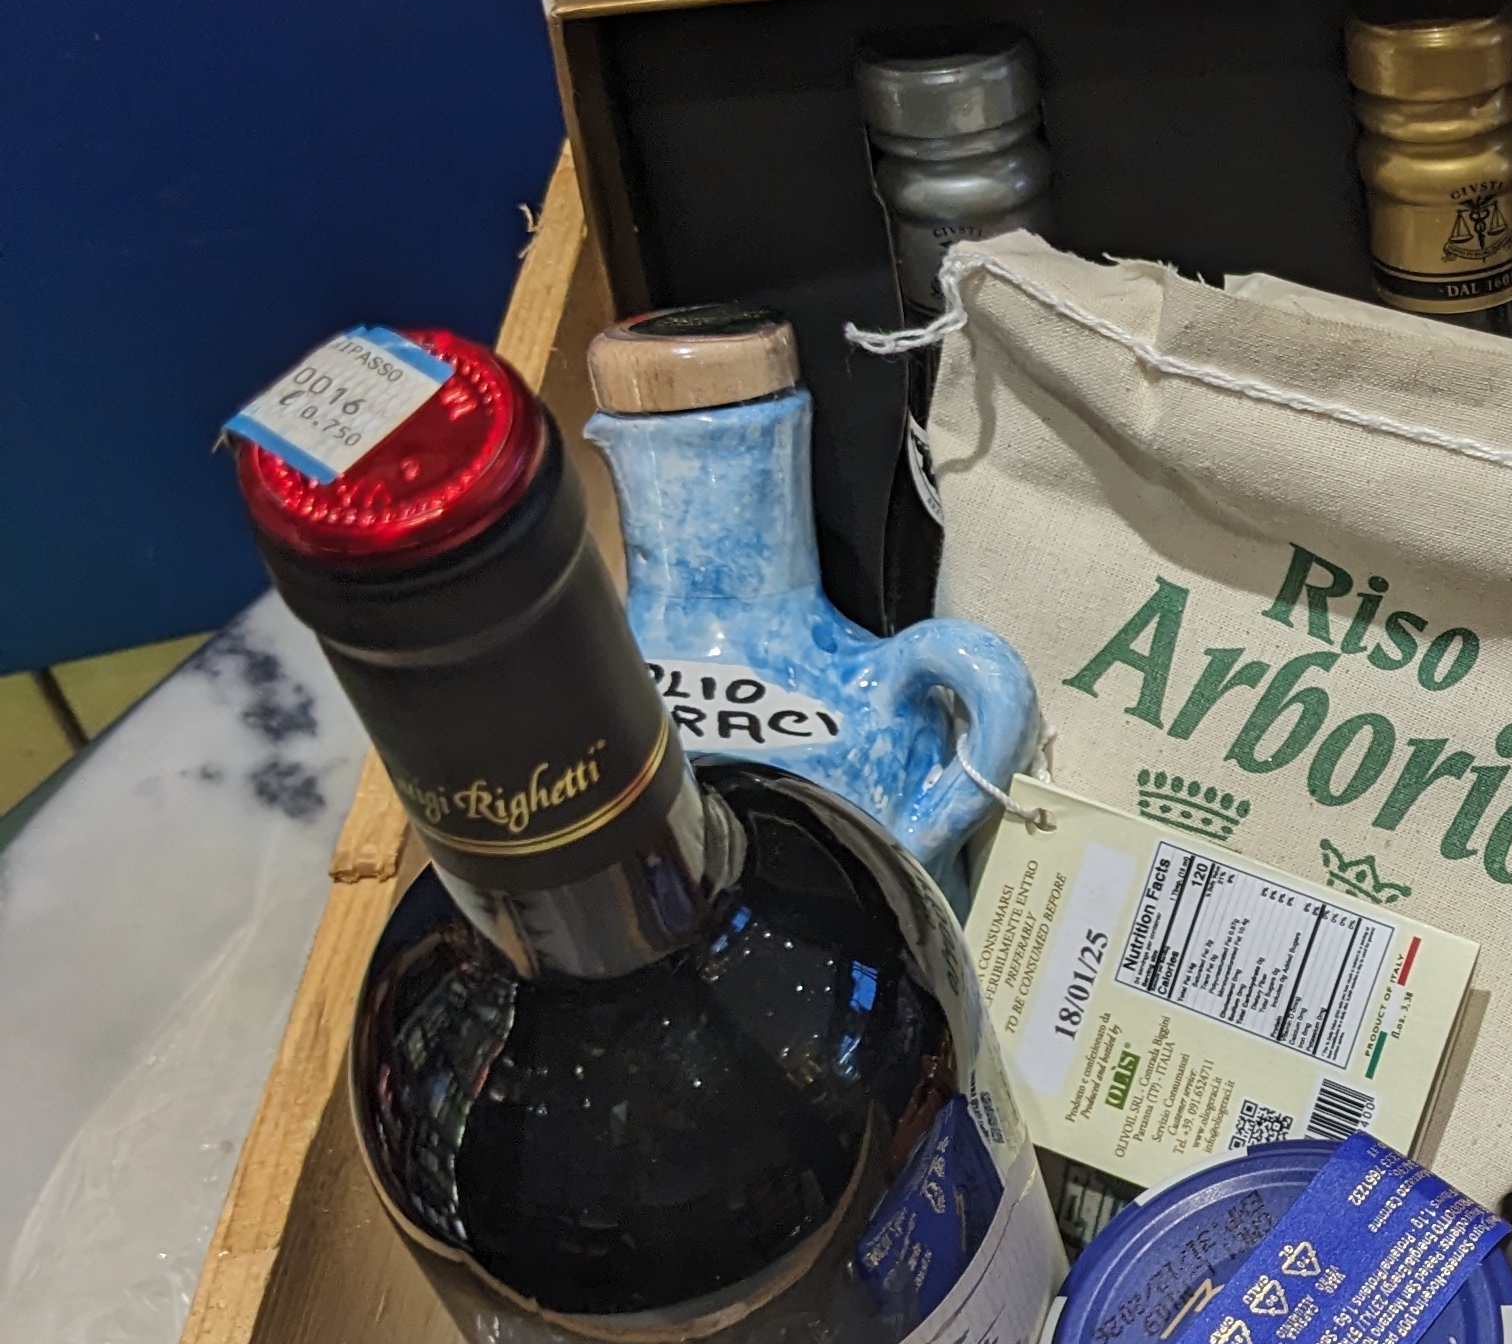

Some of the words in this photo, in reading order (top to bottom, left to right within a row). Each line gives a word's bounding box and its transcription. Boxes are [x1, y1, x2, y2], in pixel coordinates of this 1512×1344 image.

[1447, 284, 1480, 297] DAL
[325, 334, 404, 383] IPASSO
[1261, 542, 1481, 692] Riso
[668, 709, 840, 743] RACI
[455, 746, 603, 832] Righetti
[1015, 858, 1039, 906] ENTRO
[1042, 871, 1067, 922] BEFORE
[1122, 902, 1156, 971] Nutrition
[1146, 856, 1170, 901] Facts
[977, 883, 1014, 971] CONSUMARSI
[1003, 910, 1038, 988] PREFERABLY
[1017, 922, 1051, 996] CONSUMED
[1157, 949, 1179, 996] Calories
[1190, 861, 1208, 889] 120
[1011, 996, 1026, 1014] BE
[1053, 927, 1109, 1041] 18/01/25
[1363, 1003, 1387, 1057] PRODUCT
[1382, 985, 1393, 1001] OF
[1389, 952, 1405, 983] ITALY
[1004, 1014, 1019, 1034] TO
[1098, 1033, 1116, 1063] bottled
[1108, 1022, 1123, 1036] by
[1139, 1046, 1160, 1087] Contrada
[1153, 1014, 1173, 1047] Biggini
[1065, 1083, 1086, 1123] Prodotto
[1082, 1023, 1107, 1077] confezionato
[1098, 1010, 1111, 1024] da
[1092, 1062, 1106, 1081] and
[1146, 1081, 1162, 1104] (TP)
[1155, 1040, 1175, 1076] ITALIA
[1151, 1108, 1171, 1143] Servizio
[1163, 1052, 1190, 1108] Consumatori
[1079, 1080, 1100, 1119] Produced
[1167, 1097, 1187, 1136] Customer
[1172, 1136, 1187, 1156] Tel.
[1187, 1058, 1214, 1115] 091.6524711
[1191, 1075, 1223, 1149] www.oliogeraci.it
[1203, 1079, 1235, 1153] info@oliogeraci.it
[1400, 1278, 1421, 1301] San
[1413, 1248, 1445, 1284] Peeled
[1369, 1295, 1407, 1339] Marzano
